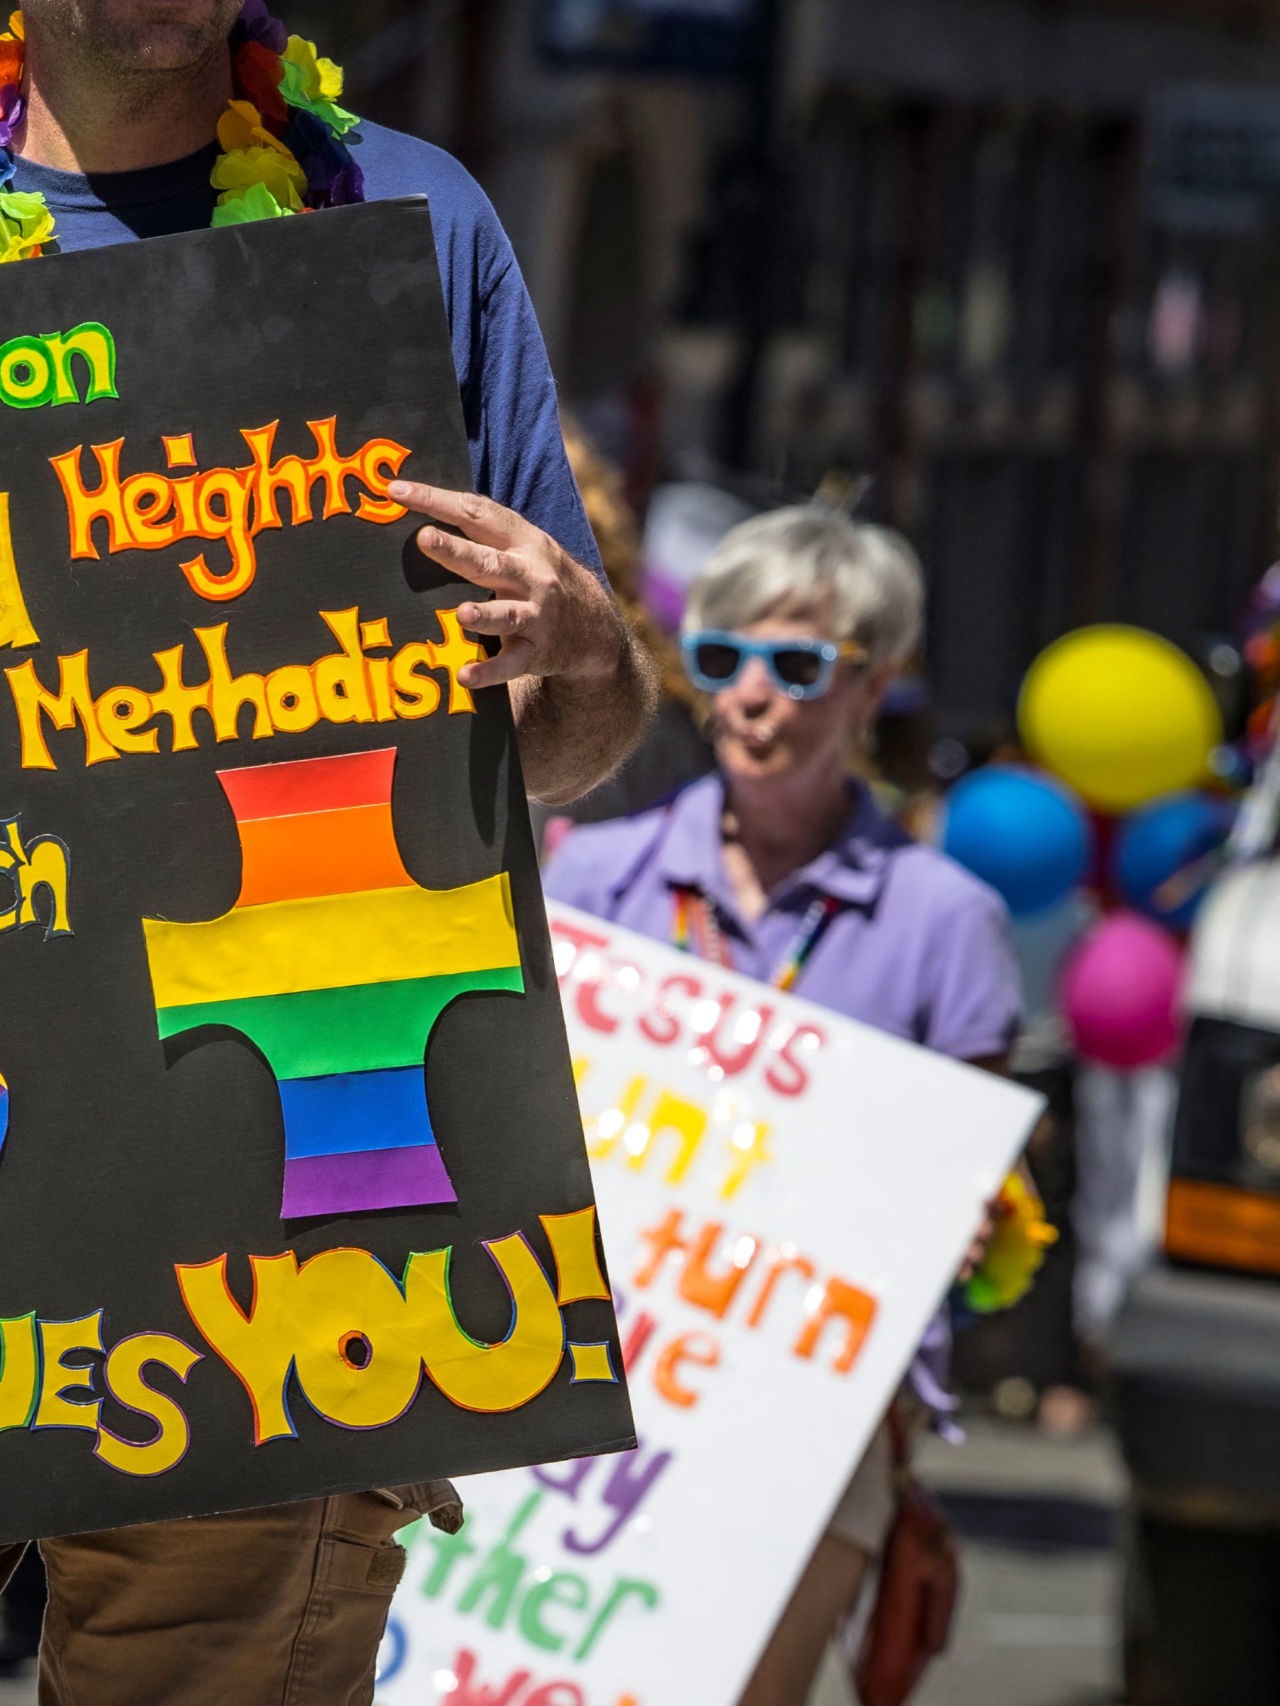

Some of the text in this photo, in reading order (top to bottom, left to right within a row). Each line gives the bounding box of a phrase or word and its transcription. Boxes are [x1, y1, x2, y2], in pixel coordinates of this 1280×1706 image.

[48, 415, 412, 601] Heights
[4, 606, 488, 771] Methodist
[175, 1205, 620, 1447] YOU!
[632, 1206, 882, 1376] turn
